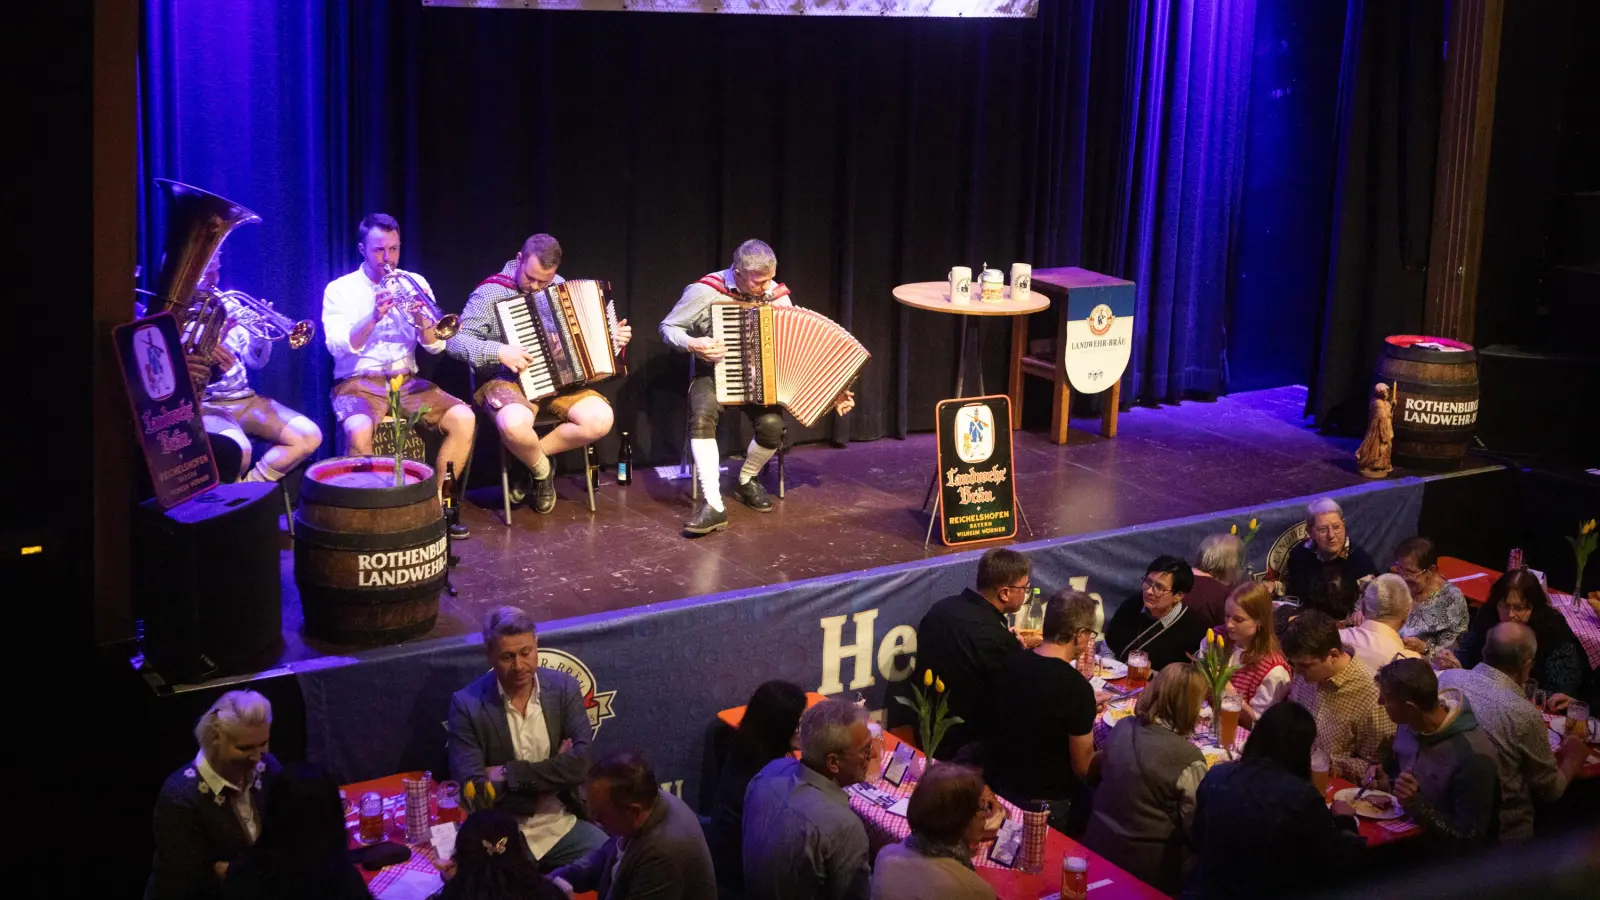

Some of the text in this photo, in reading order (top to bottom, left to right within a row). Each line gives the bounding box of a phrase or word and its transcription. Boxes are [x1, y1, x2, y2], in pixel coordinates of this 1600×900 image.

[1071, 337, 1126, 350] LANDWEHR-BRÄU
[1403, 411, 1477, 426] LANDWEHR-B
[945, 464, 1007, 487] Landwehr
[949, 511, 1010, 525] REICHELSHOFEN
